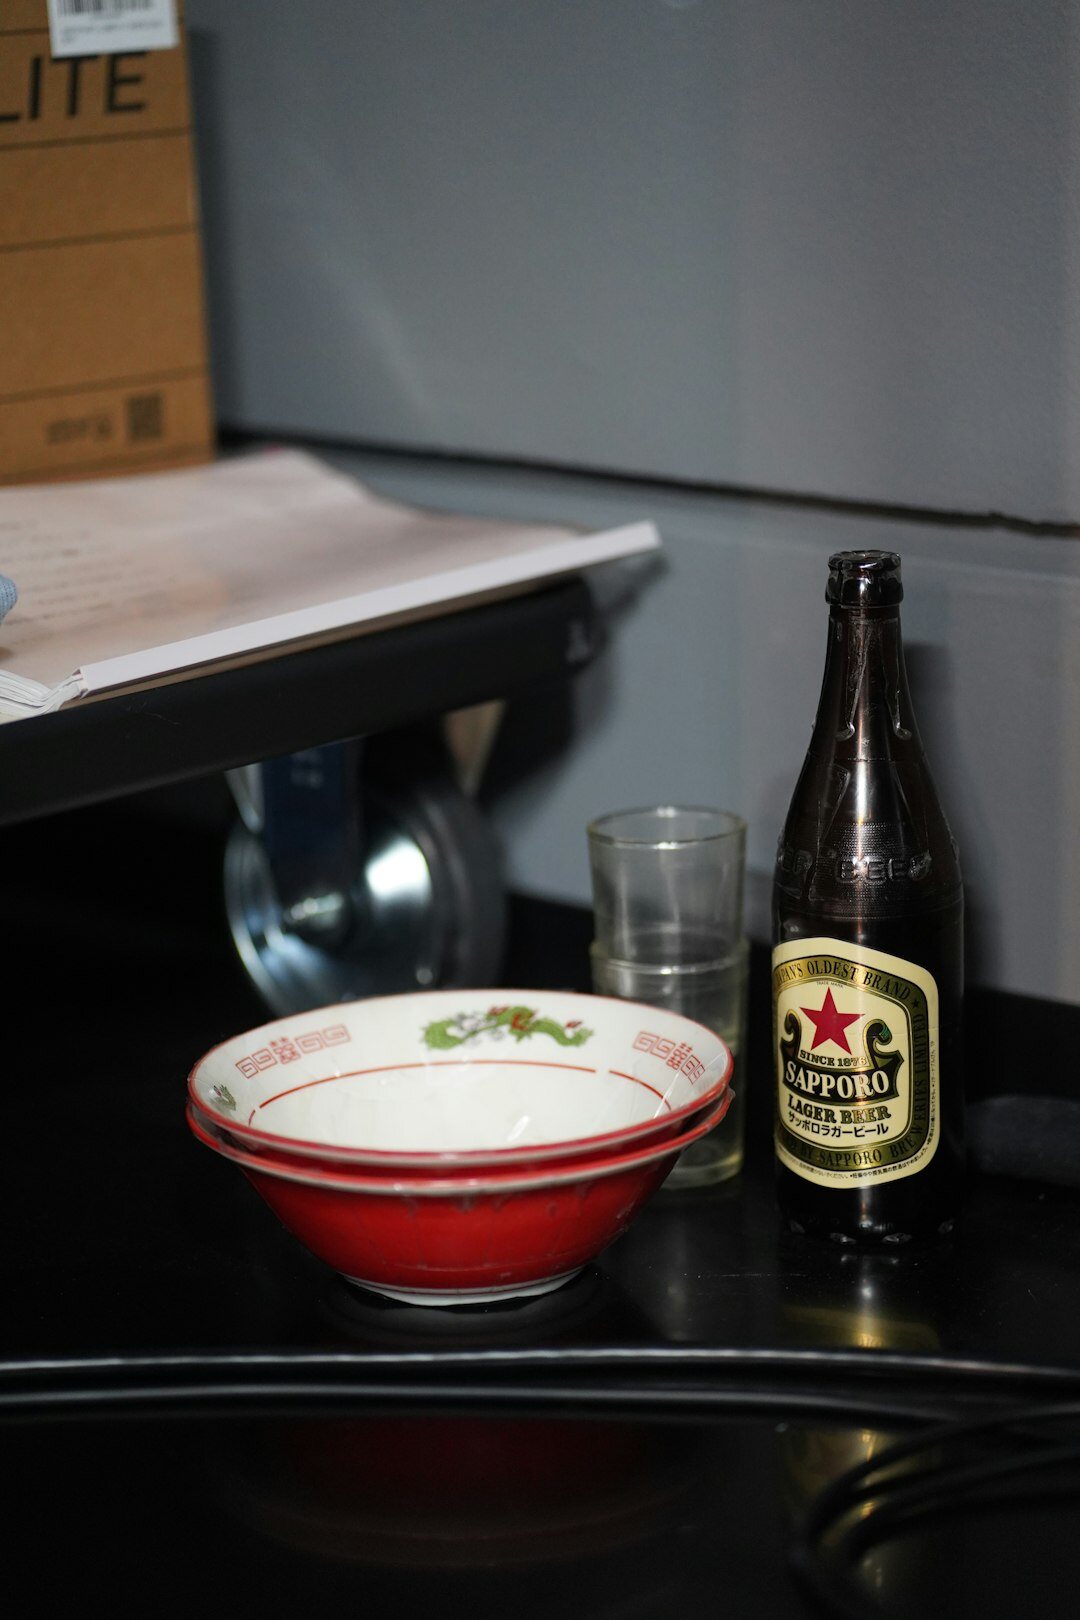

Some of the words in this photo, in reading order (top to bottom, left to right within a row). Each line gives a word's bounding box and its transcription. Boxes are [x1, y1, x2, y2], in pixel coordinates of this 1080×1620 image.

[807, 959, 859, 982] OLDEST
[863, 971, 911, 1001] BRAND
[799, 1049, 835, 1067] SINCE
[785, 1060, 890, 1099] SAPPORO
[818, 1149, 882, 1167] SAPPORO
[913, 1013, 928, 1075] LIMITED
[788, 1093, 837, 1124] LAGER
[839, 1105, 892, 1124] BEER
[788, 1111, 889, 1138] サッポロラガービール
